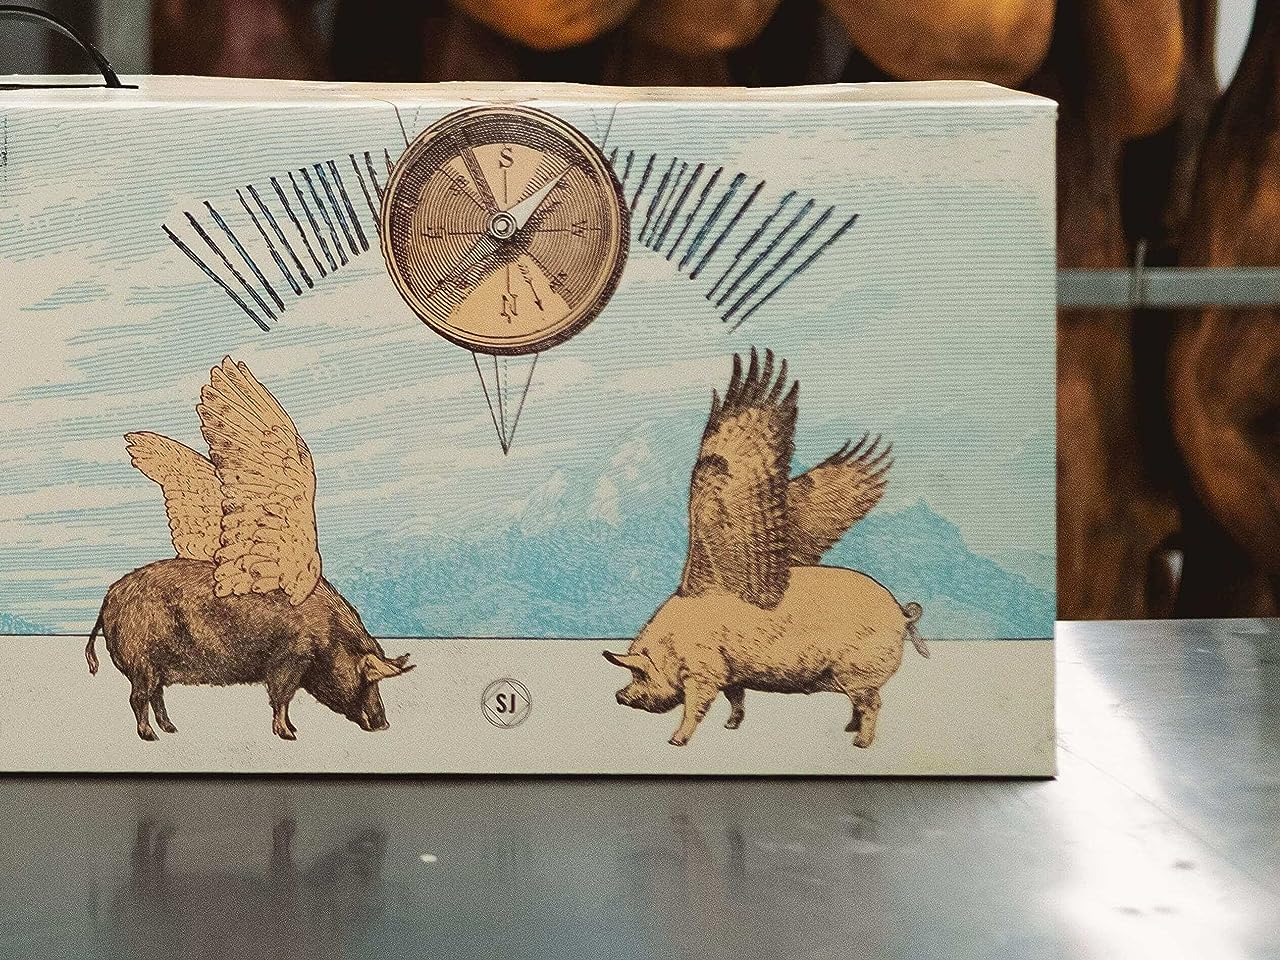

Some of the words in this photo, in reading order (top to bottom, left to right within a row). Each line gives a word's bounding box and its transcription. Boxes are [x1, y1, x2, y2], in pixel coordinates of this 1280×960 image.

[498, 146, 514, 168] S
[500, 292, 518, 323] N
[496, 693, 515, 714] SJ
